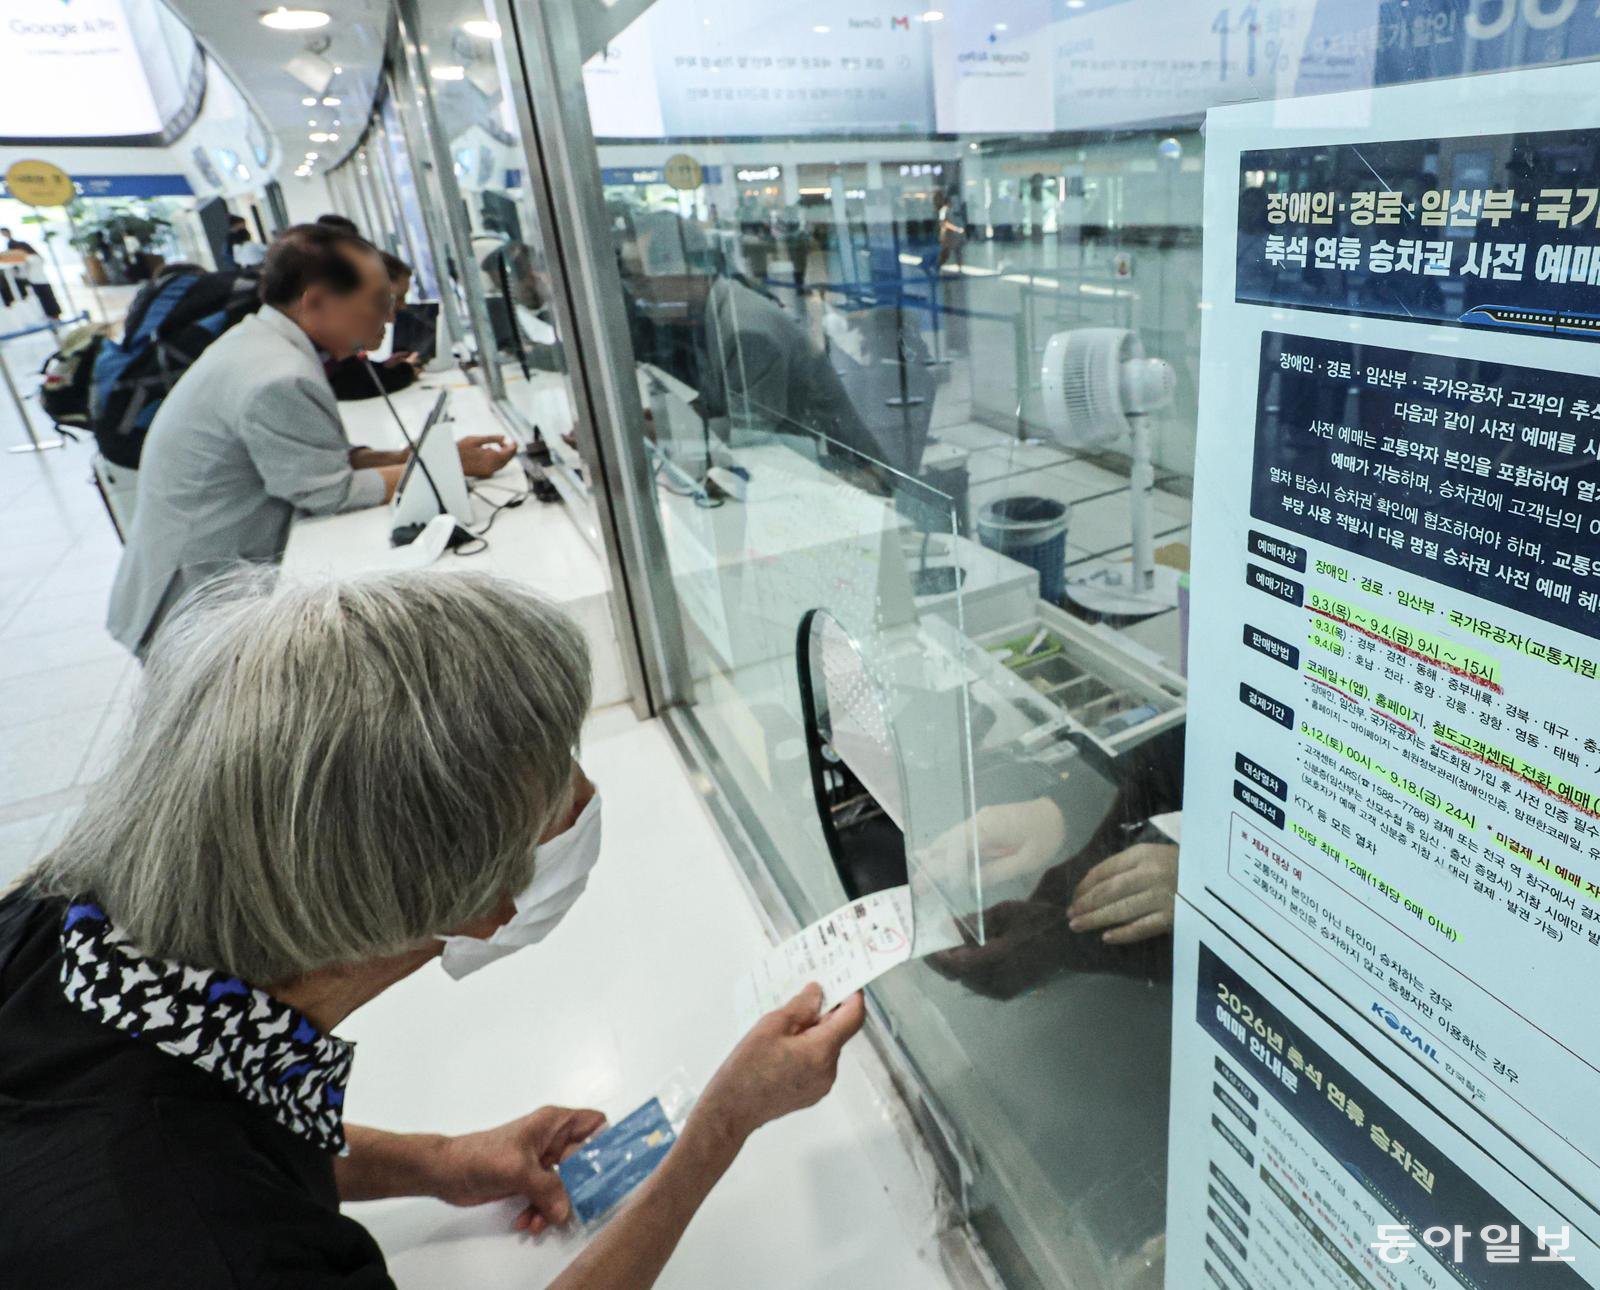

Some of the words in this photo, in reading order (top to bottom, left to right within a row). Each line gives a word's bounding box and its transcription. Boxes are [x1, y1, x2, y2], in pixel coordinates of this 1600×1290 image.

[1265, 234, 1308, 268] 추석
[1315, 236, 1362, 271] 연휴
[1368, 238, 1453, 277] 승차권
[1459, 242, 1526, 281] 사전
[1279, 352, 1314, 374] 장애인
[1326, 360, 1351, 379] 경로
[1366, 366, 1407, 390] 임산부
[1422, 375, 1503, 407] 국가유공자
[1507, 391, 1564, 418] 고객의
[1309, 420, 1334, 439] 사전
[1338, 426, 1377, 449] 예매는
[1380, 436, 1439, 465] 교통약자
[1443, 449, 1491, 478] 본인을
[1496, 463, 1569, 496] 포함하여
[1394, 402, 1438, 426] 다음과
[1443, 411, 1475, 434] 같이
[1480, 419, 1515, 442] 사전
[1521, 427, 1576, 455] 예매를
[1269, 466, 1292, 486] 열차
[1295, 474, 1331, 498] 탑승시
[1334, 486, 1372, 511] 승차권
[1377, 498, 1419, 525] 확인에
[1423, 511, 1502, 550] 협조하여야
[1507, 536, 1546, 565] 하며,
[1331, 452, 1369, 476] 예매가
[1373, 463, 1433, 496] 가능하며,
[1439, 480, 1503, 512] 승차권에
[1507, 499, 1582, 533] 고객님의
[1257, 539, 1297, 564] 예매대상
[1281, 495, 1304, 515] 부당
[1307, 504, 1332, 525] 사용
[1335, 512, 1374, 539] 적발시
[1378, 526, 1405, 550] 다음
[1410, 536, 1439, 560] 명절
[1443, 547, 1491, 578] 승차권
[1495, 564, 1530, 590] 사전
[1536, 577, 1572, 604] 예매
[1255, 572, 1294, 599] 예매기간
[1315, 560, 1348, 583] 장애인
[1360, 576, 1384, 596] 경로
[1397, 590, 1436, 615] 임산부
[1252, 632, 1290, 661] 판매방법
[1370, 618, 1413, 648] 9.4.(금)
[1417, 638, 1439, 658] 9시
[1463, 658, 1494, 681] 15시
[1248, 691, 1285, 721] 결제기간
[1354, 654, 1374, 671] 호남
[1384, 667, 1404, 685] 전라
[1414, 680, 1435, 698] 중앙
[1479, 711, 1503, 731] 장항
[1515, 728, 1540, 748] 영동
[1553, 746, 1580, 768] 태백
[1358, 637, 1376, 653] 경부
[1386, 649, 1407, 667] 경전
[1416, 663, 1437, 681] 동해
[1448, 677, 1493, 707] 중부내륙
[1505, 703, 1529, 724] 경북
[1543, 720, 1569, 739] 대구
[1370, 713, 1426, 750] 국가유공자는
[1429, 744, 1471, 774] 철도회원
[1474, 767, 1497, 787] 가입
[1515, 789, 1540, 810] 사전
[1544, 802, 1569, 824] 인증
[1573, 816, 1600, 838] 필수
[1432, 720, 1515, 773] 철도고객센터
[1521, 763, 1552, 789] 전화
[1294, 794, 1314, 815] KTX
[1330, 818, 1351, 839] 모든
[1355, 833, 1377, 855] 열차
[1346, 747, 1371, 770] 00시
[1445, 802, 1476, 829] 24시
[1537, 855, 1550, 870] 시
[1554, 865, 1582, 888] 예매
[1293, 823, 1317, 847] 1인당
[1320, 842, 1341, 863] 최대
[1404, 899, 1424, 920] 6매
[1420, 829, 1440, 849] 임신
[1516, 888, 1541, 910] 지참
[1545, 906, 1583, 935] 시에만
[1433, 819, 1454, 839] 결제
[1457, 833, 1479, 854] 또는
[1483, 847, 1506, 869] 전국
[1510, 863, 1522, 878] 역
[1526, 873, 1576, 910] 창구에서
[1216, 1004, 1246, 1045] 예매
[1371, 1001, 1440, 1065] KORAIL
[1216, 982, 1284, 1056] 2026년
[1287, 1045, 1323, 1092] 추석
[1326, 1081, 1365, 1128] 연휴
[1369, 1122, 1435, 1195] 승차권
